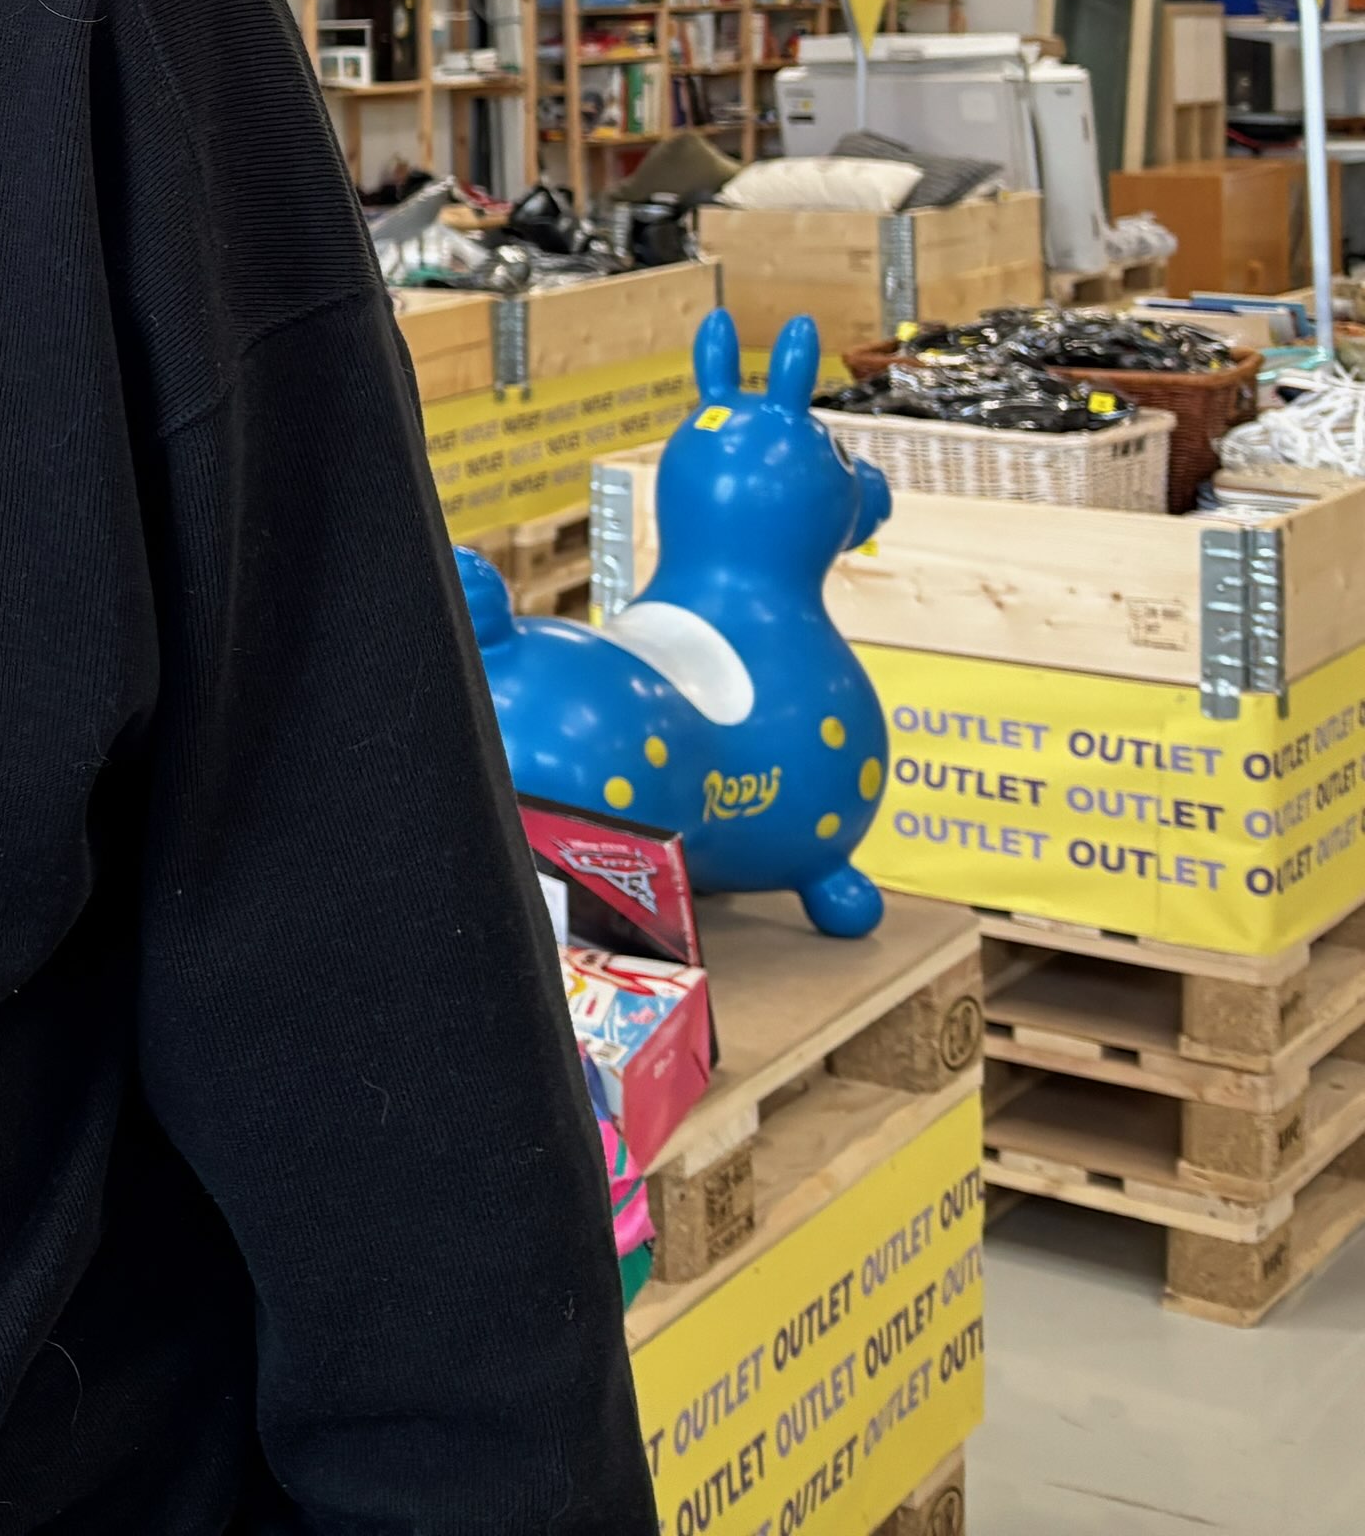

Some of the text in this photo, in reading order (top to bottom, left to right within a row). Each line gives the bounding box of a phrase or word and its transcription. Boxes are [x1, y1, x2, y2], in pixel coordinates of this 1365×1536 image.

[893, 705, 1050, 752] OUTLET
[1068, 729, 1223, 777] OUTLET
[894, 757, 1047, 806] OUTLET
[1066, 785, 1225, 833] OUTLET
[893, 809, 1051, 860] OUTLET
[1068, 839, 1225, 891] OUTLET
[673, 1344, 765, 1458] OUTLET
[773, 1269, 855, 1373] OUTLET
[861, 1204, 935, 1297] OUTLET
[939, 1165, 985, 1231] OUTL
[677, 1430, 767, 1536] OUTLET
[776, 1351, 857, 1459] OUTLET
[863, 1281, 937, 1380] OUTLET
[941, 1243, 984, 1307] OUTL
[780, 1435, 859, 1536] OUTLET
[863, 1358, 934, 1458] OUTLET
[940, 1315, 985, 1384] OUTL
